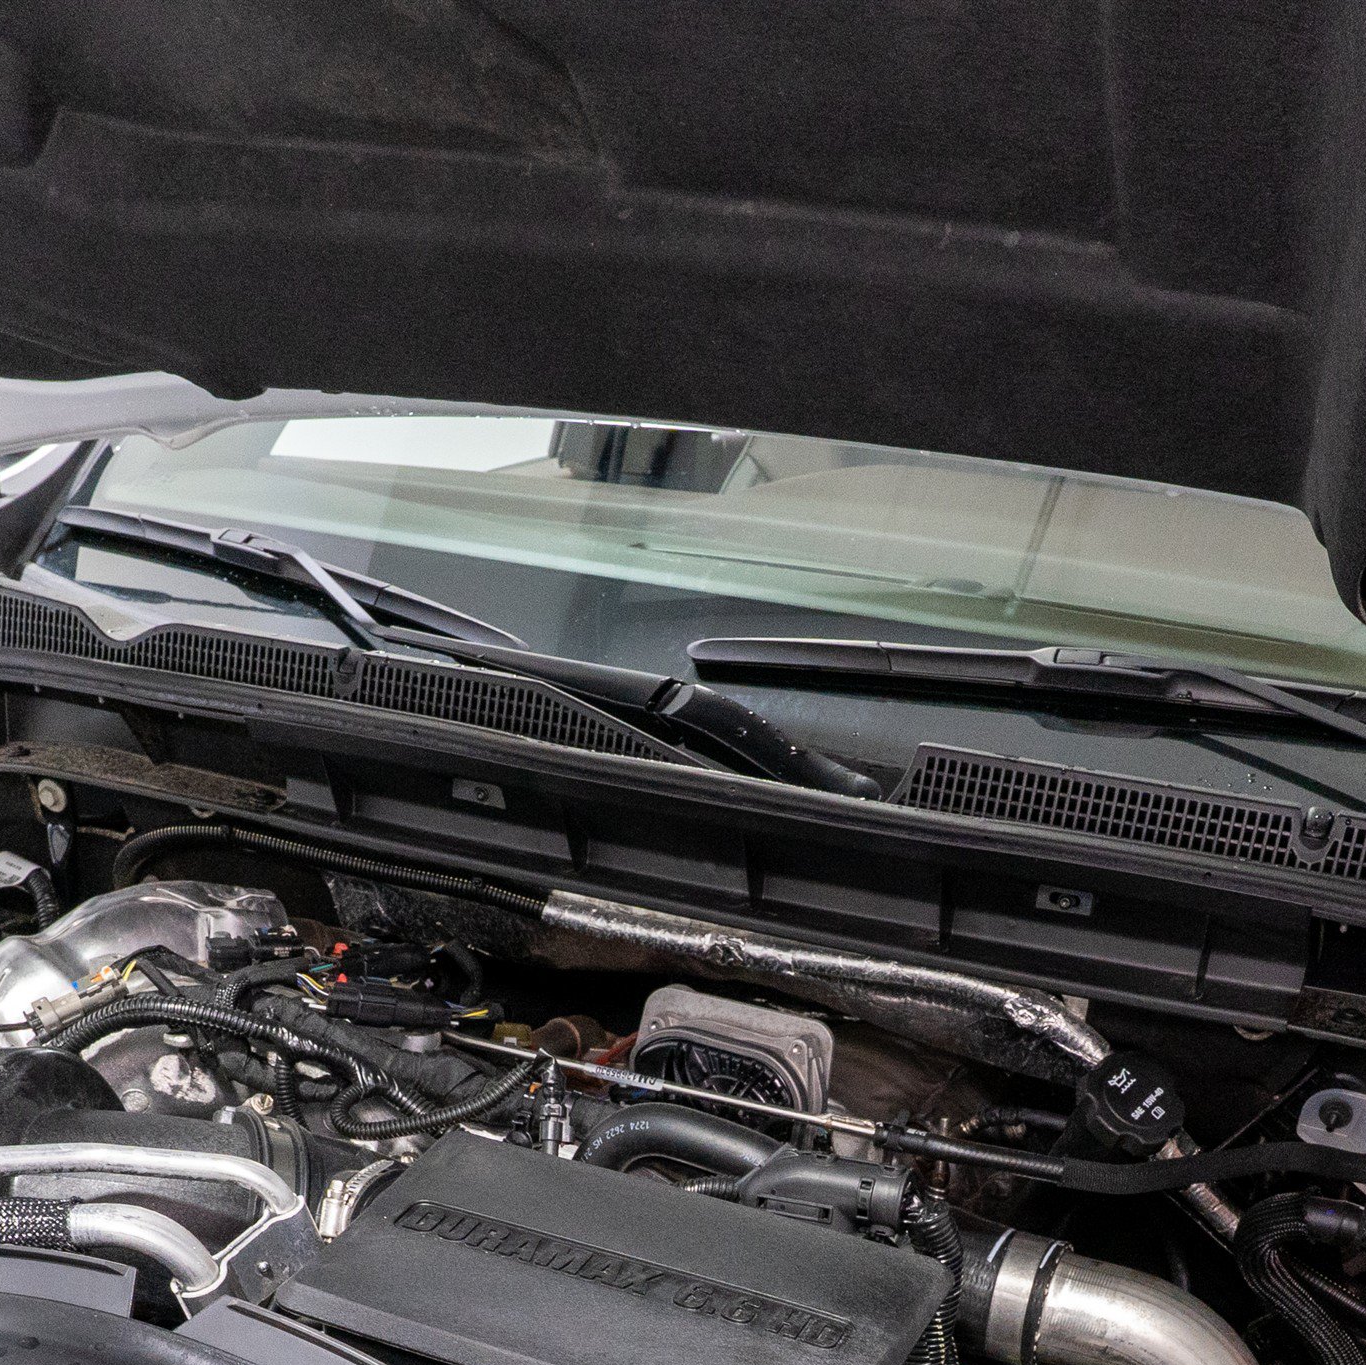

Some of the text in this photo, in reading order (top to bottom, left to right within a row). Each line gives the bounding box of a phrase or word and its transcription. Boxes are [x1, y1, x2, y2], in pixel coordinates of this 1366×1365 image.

[1130, 1087, 1164, 1120] SAE 15W-40
[402, 1206, 855, 1350] DURAMAX 6.6 HD
